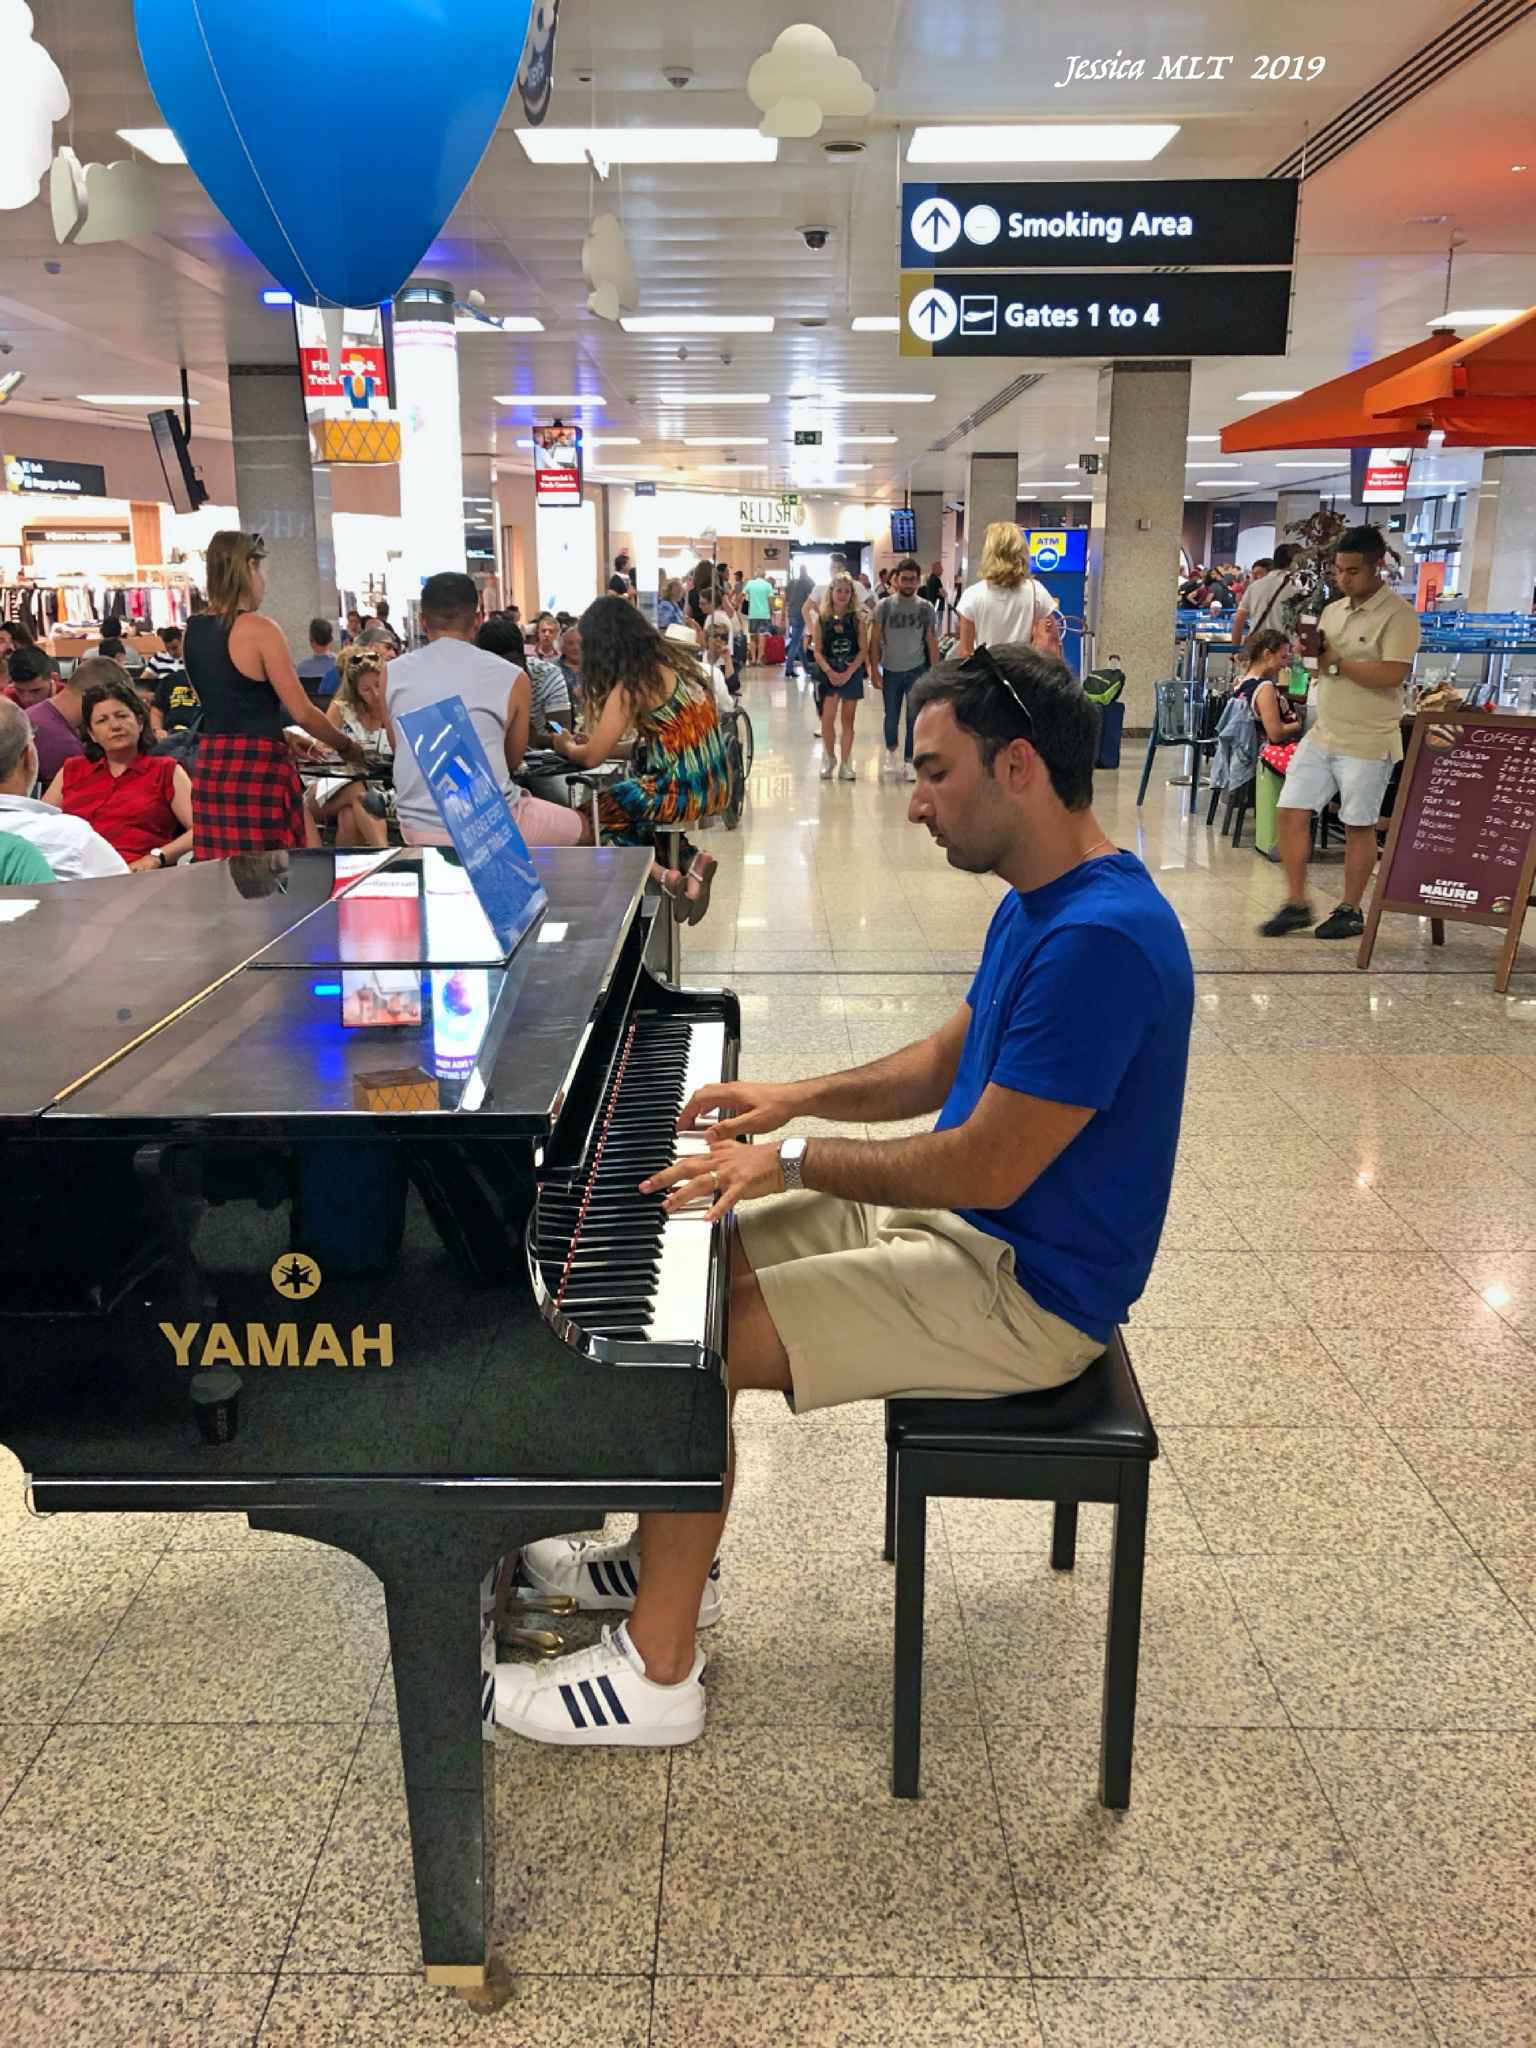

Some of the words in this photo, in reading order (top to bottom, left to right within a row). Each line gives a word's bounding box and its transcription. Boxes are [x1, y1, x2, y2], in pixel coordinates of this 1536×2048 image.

[1008, 211, 1123, 243] Smoking
[1130, 212, 1193, 236] Area
[1004, 303, 1079, 327] Gates
[1088, 303, 1100, 327] 1
[1108, 304, 1137, 327] to
[1143, 303, 1161, 327] 4
[740, 501, 791, 523] RELISH
[1471, 730, 1529, 745] COFFEE
[1419, 884, 1479, 901] MAURO
[158, 1322, 394, 1366] YAMAH
